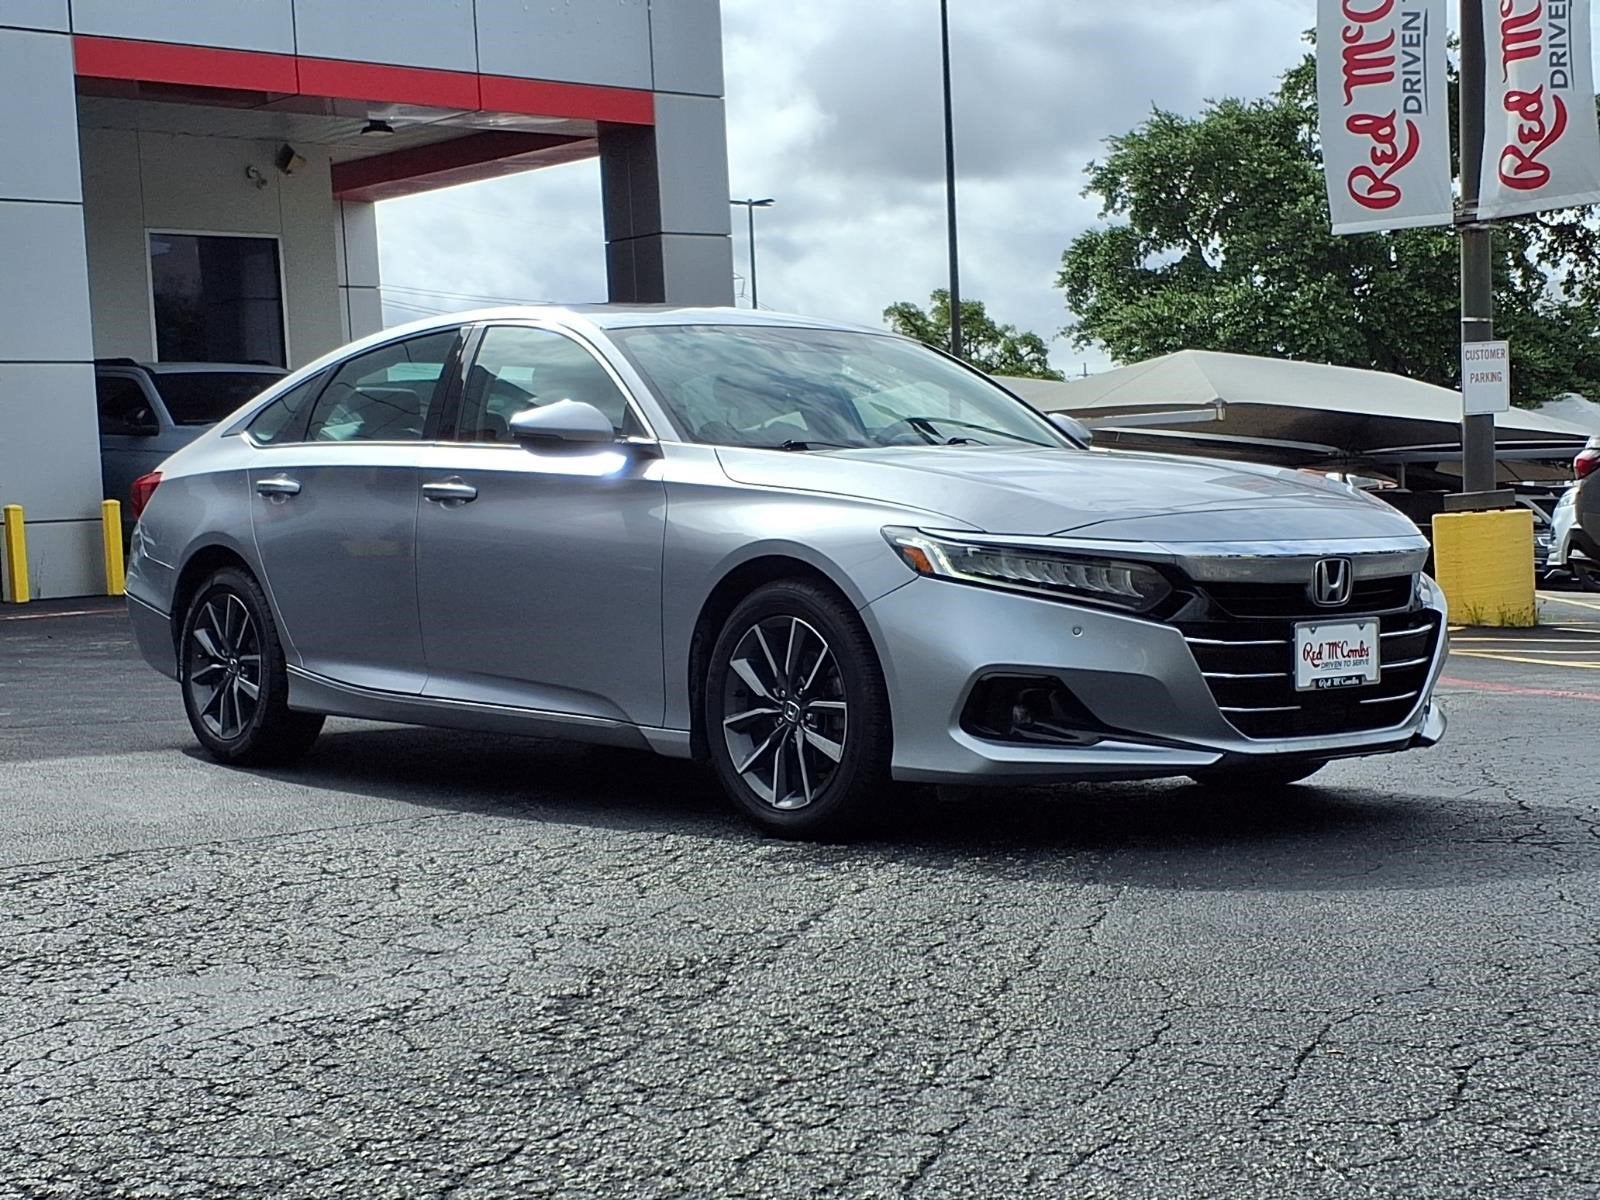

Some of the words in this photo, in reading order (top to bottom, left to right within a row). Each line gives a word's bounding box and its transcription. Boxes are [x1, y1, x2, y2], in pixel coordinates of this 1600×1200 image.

[1401, 11, 1422, 115] DRIVEN
[1547, 0, 1569, 89] DRIVE
[1347, 109, 1420, 210] Red
[1499, 84, 1568, 190] Red
[1465, 348, 1506, 361] CUSTOMER
[1470, 371, 1502, 384] PARKING
[1302, 641, 1323, 668] Red
[1325, 640, 1370, 660] McCombs
[1320, 660, 1342, 669] DRIVEN
[1343, 659, 1352, 667] TO
